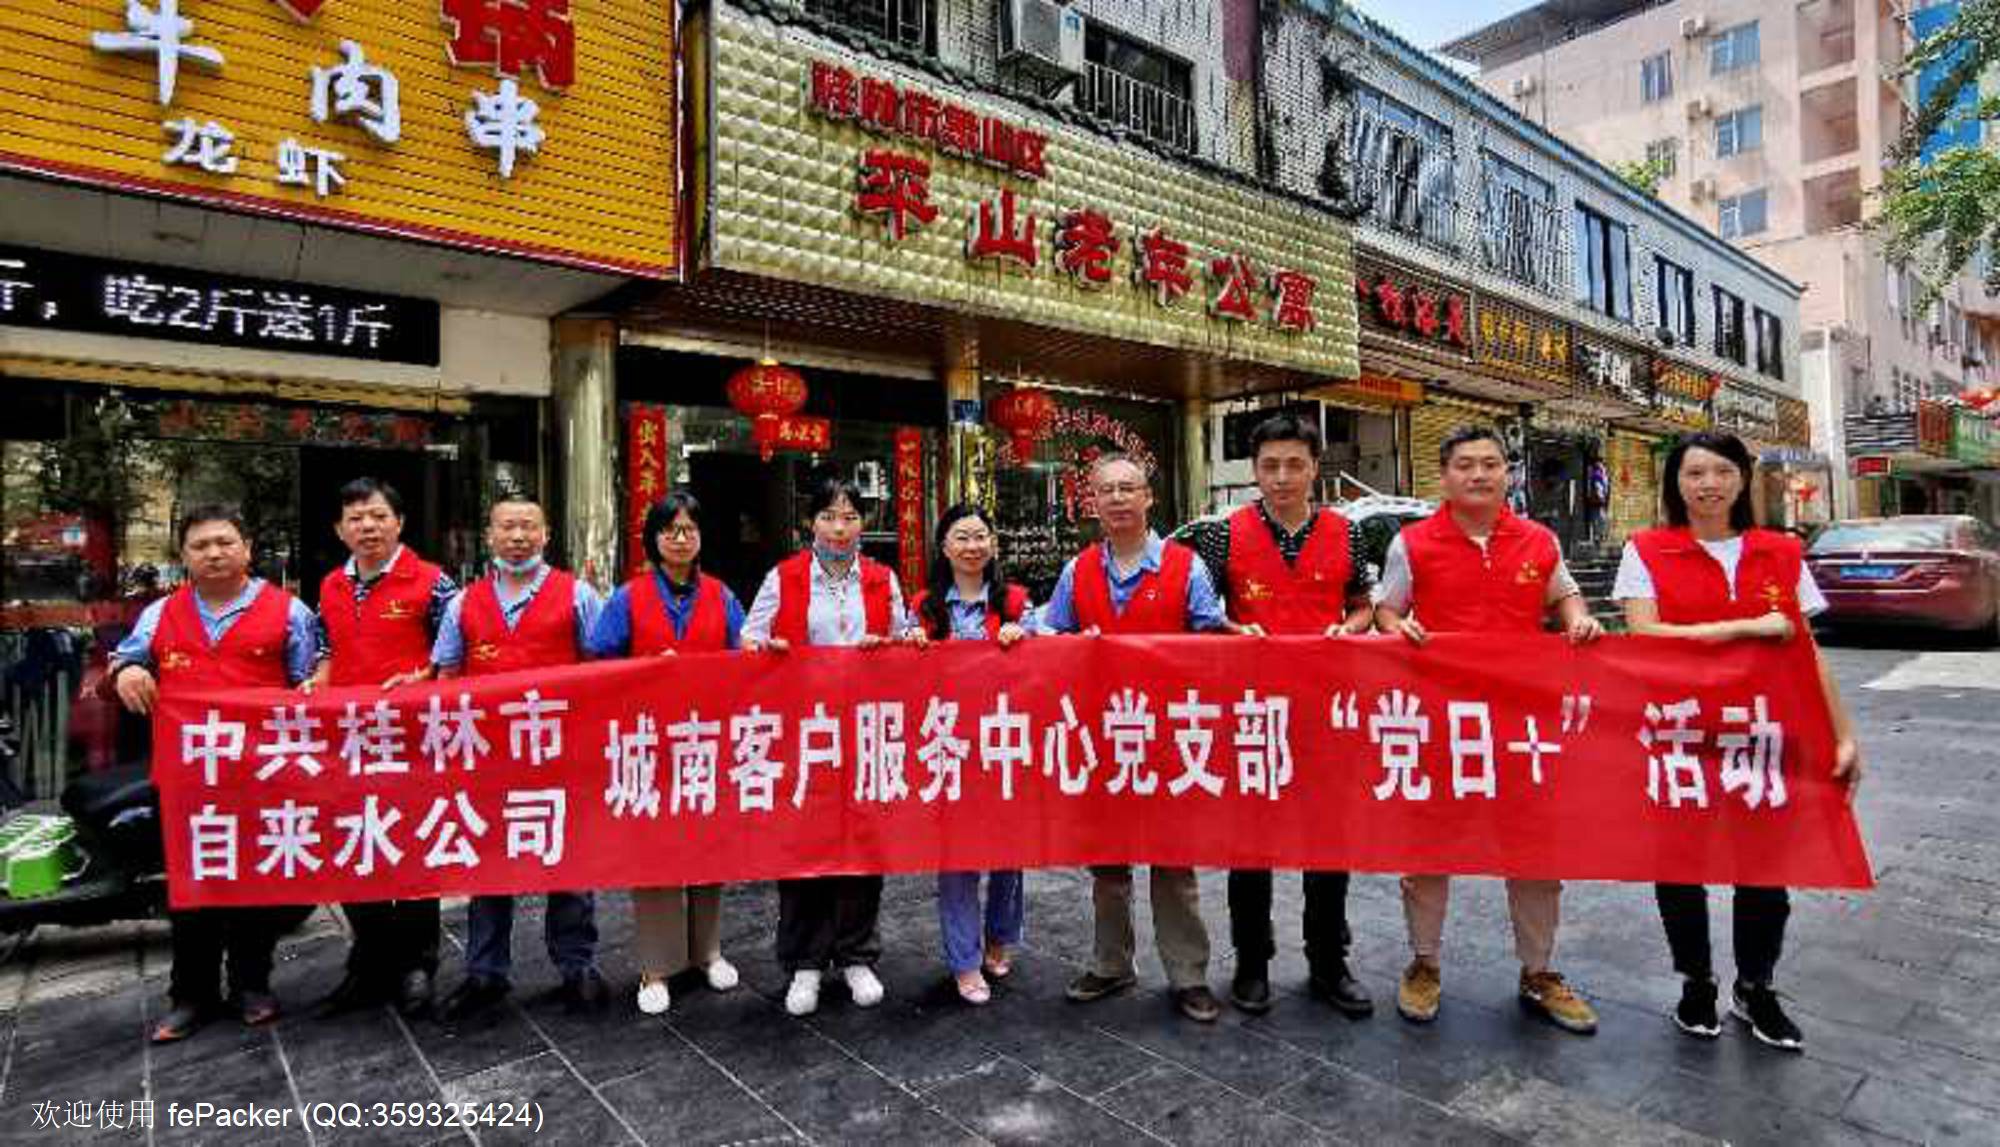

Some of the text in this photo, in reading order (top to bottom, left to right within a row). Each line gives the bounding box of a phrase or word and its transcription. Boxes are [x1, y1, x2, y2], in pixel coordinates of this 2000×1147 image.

[161, 118, 346, 196] 龙虾
[856, 148, 1318, 332] 平山老年公寓
[181, 689, 569, 786] 中共桂林市
[187, 787, 566, 881] 自来水公司
